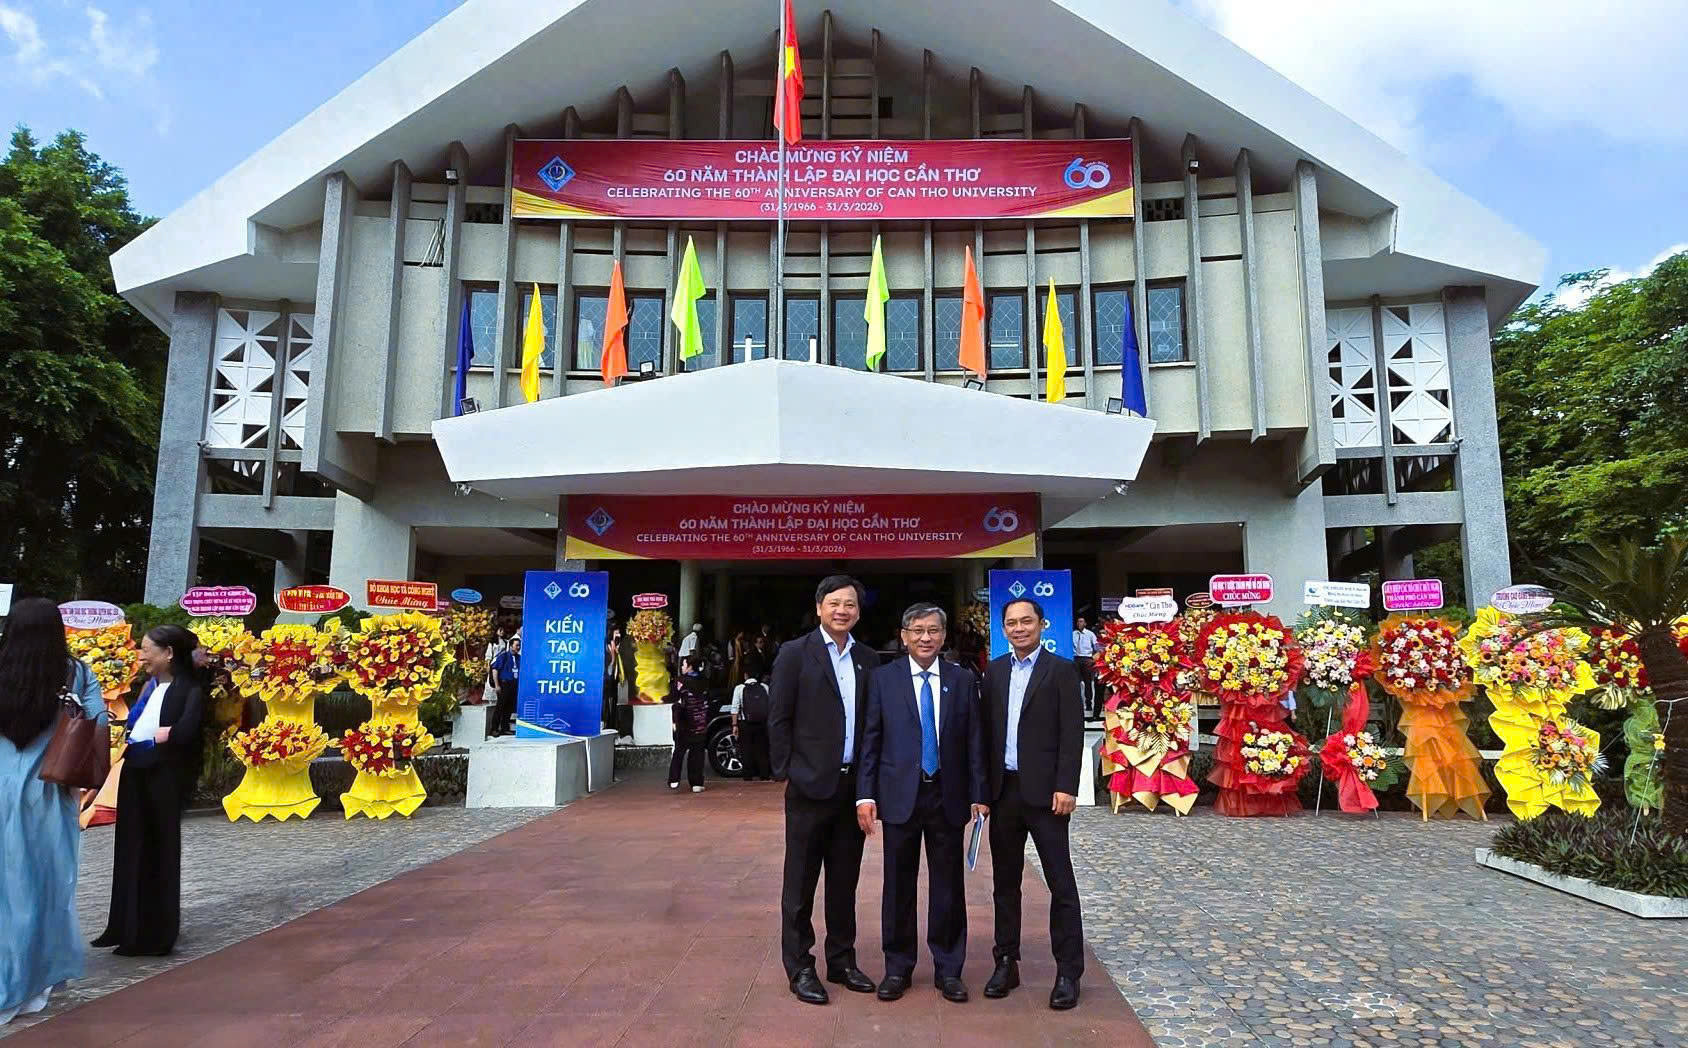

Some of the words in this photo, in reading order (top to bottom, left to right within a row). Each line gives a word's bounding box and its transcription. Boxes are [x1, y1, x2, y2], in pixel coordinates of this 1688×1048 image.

[735, 147, 781, 163] CHÀO
[785, 147, 836, 163] MỪNG
[840, 146, 862, 163] KỶ
[867, 146, 909, 165] NIỆM
[663, 169, 687, 182] 60
[690, 165, 728, 182] NĂM
[732, 166, 790, 182] THÀNH
[794, 165, 827, 184] LẬP
[832, 168, 860, 184] ĐẠI
[865, 168, 900, 184] HỌC
[904, 162, 939, 182] CẦN
[943, 168, 981, 182] THƠ
[1064, 157, 1111, 189] 60
[607, 187, 701, 198] CELEBRATING
[705, 187, 731, 198] THE
[764, 187, 862, 198] ANNIVERSARY
[866, 187, 883, 198] OF
[888, 187, 916, 198] CAN
[920, 187, 948, 197] THO
[952, 186, 1038, 197] UNIVERSITY
[826, 202, 884, 213] 31/3/2026)
[733, 500, 769, 514] CHÀO
[771, 500, 810, 514] MỪNG
[813, 500, 830, 514] KỶ
[833, 500, 865, 515] NIỆM
[679, 519, 697, 529] 60
[700, 516, 728, 529] NĂM
[732, 516, 775, 529] THÀNH
[778, 516, 804, 531] LẬP
[807, 518, 829, 531] ĐẠI
[832, 518, 859, 531] HỌC
[862, 513, 889, 529] CẦN
[891, 517, 921, 528] THƠ
[982, 506, 1018, 532] 60
[636, 533, 708, 542] CELEBRATING
[711, 533, 731, 542] THE
[756, 533, 829, 542] ANNIVERSARY
[832, 533, 846, 542] OF
[849, 533, 871, 541] CAN
[873, 532, 896, 541] THO
[898, 532, 963, 541] UNIVERSITY
[568, 582, 590, 598] 60
[545, 613, 584, 633] KIẾN
[547, 640, 580, 657] TẠO
[549, 660, 576, 674] TRI
[536, 677, 586, 694] THỨC
